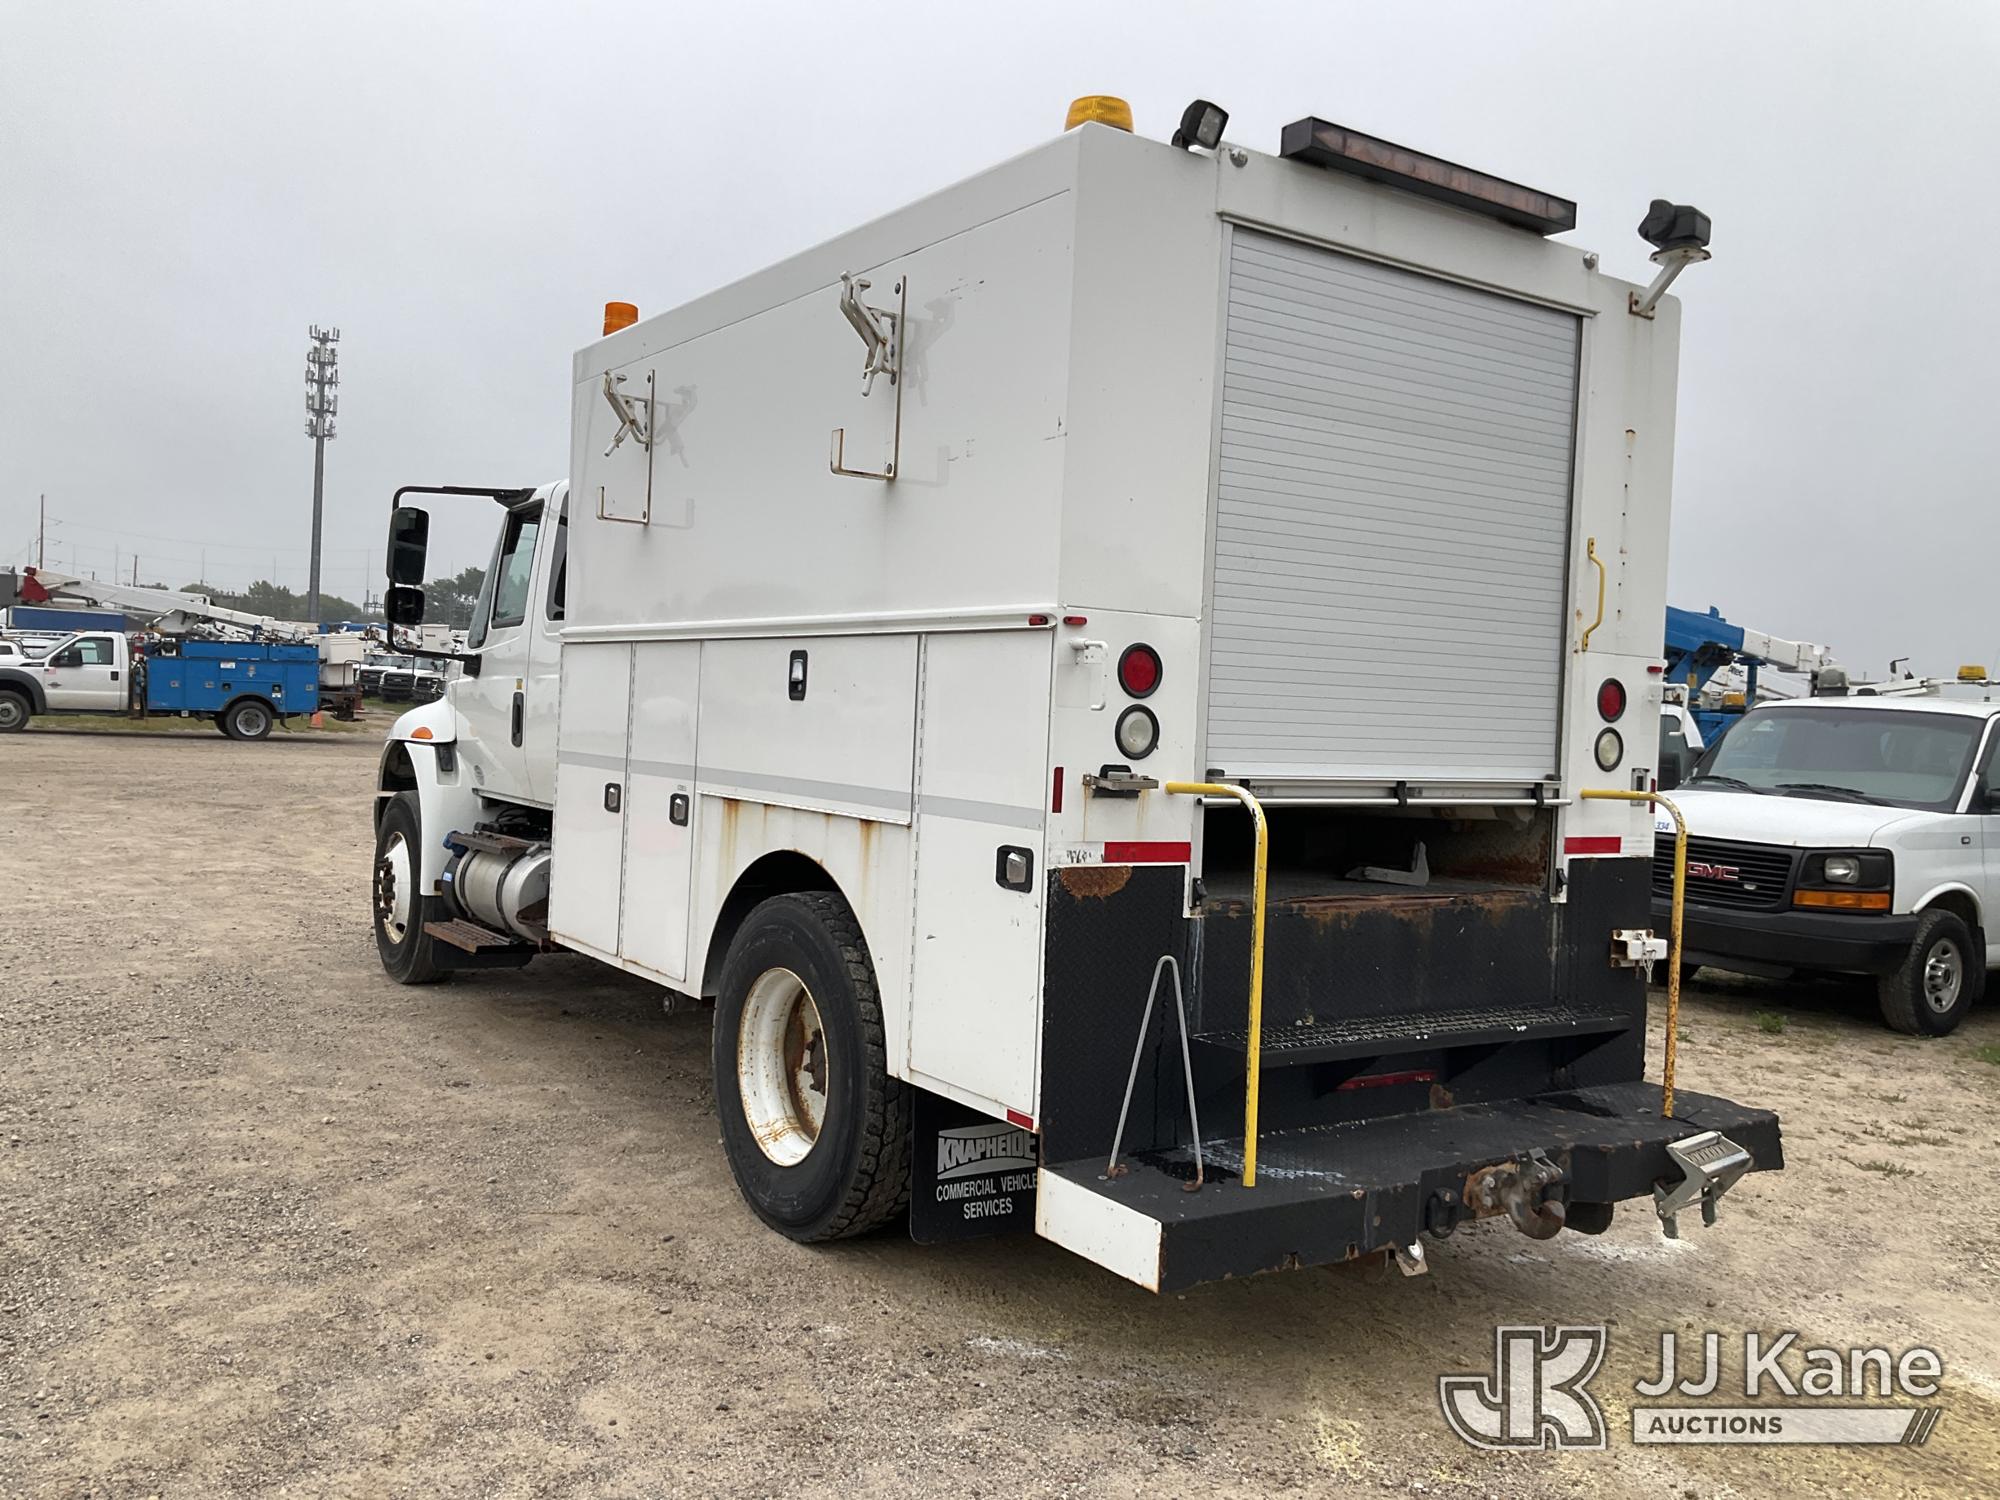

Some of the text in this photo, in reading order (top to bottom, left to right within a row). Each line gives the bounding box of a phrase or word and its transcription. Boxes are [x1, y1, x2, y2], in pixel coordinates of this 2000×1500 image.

[1686, 861, 1740, 881] GMC
[937, 1129, 1037, 1173] KNAPHEIDE
[936, 1173, 1037, 1202] COMMERCIAL VEHICLE
[963, 1198, 1013, 1219] SERVICES
